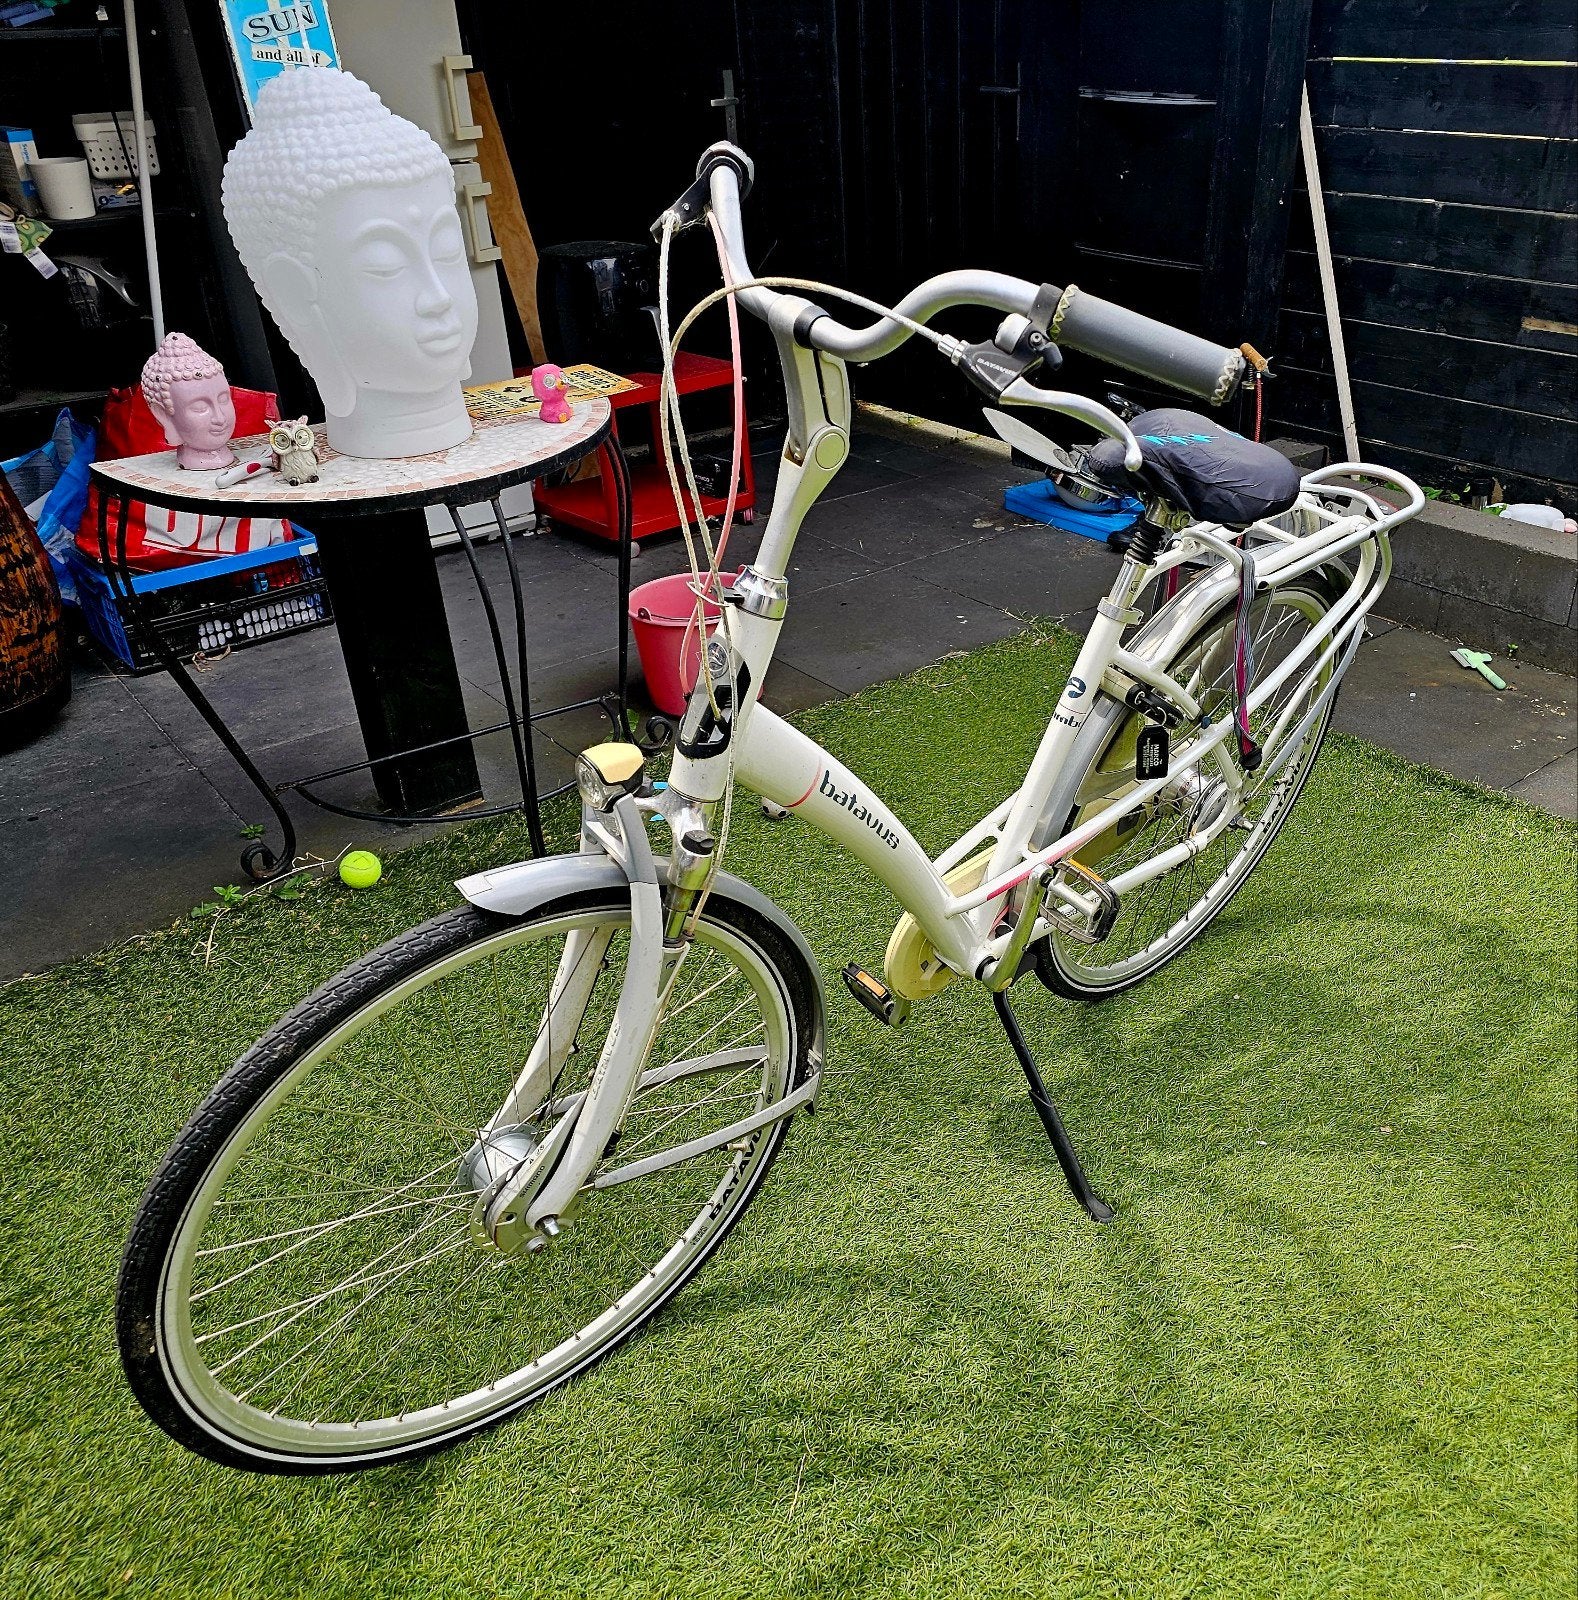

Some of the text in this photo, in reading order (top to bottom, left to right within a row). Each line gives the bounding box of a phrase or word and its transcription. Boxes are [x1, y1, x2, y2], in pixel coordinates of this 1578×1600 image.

[248, 4, 314, 38] SUN
[256, 50, 282, 61] and
[286, 51, 302, 63] all
[820, 769, 900, 850] batavus
[688, 1129, 763, 1221] BATAVU
